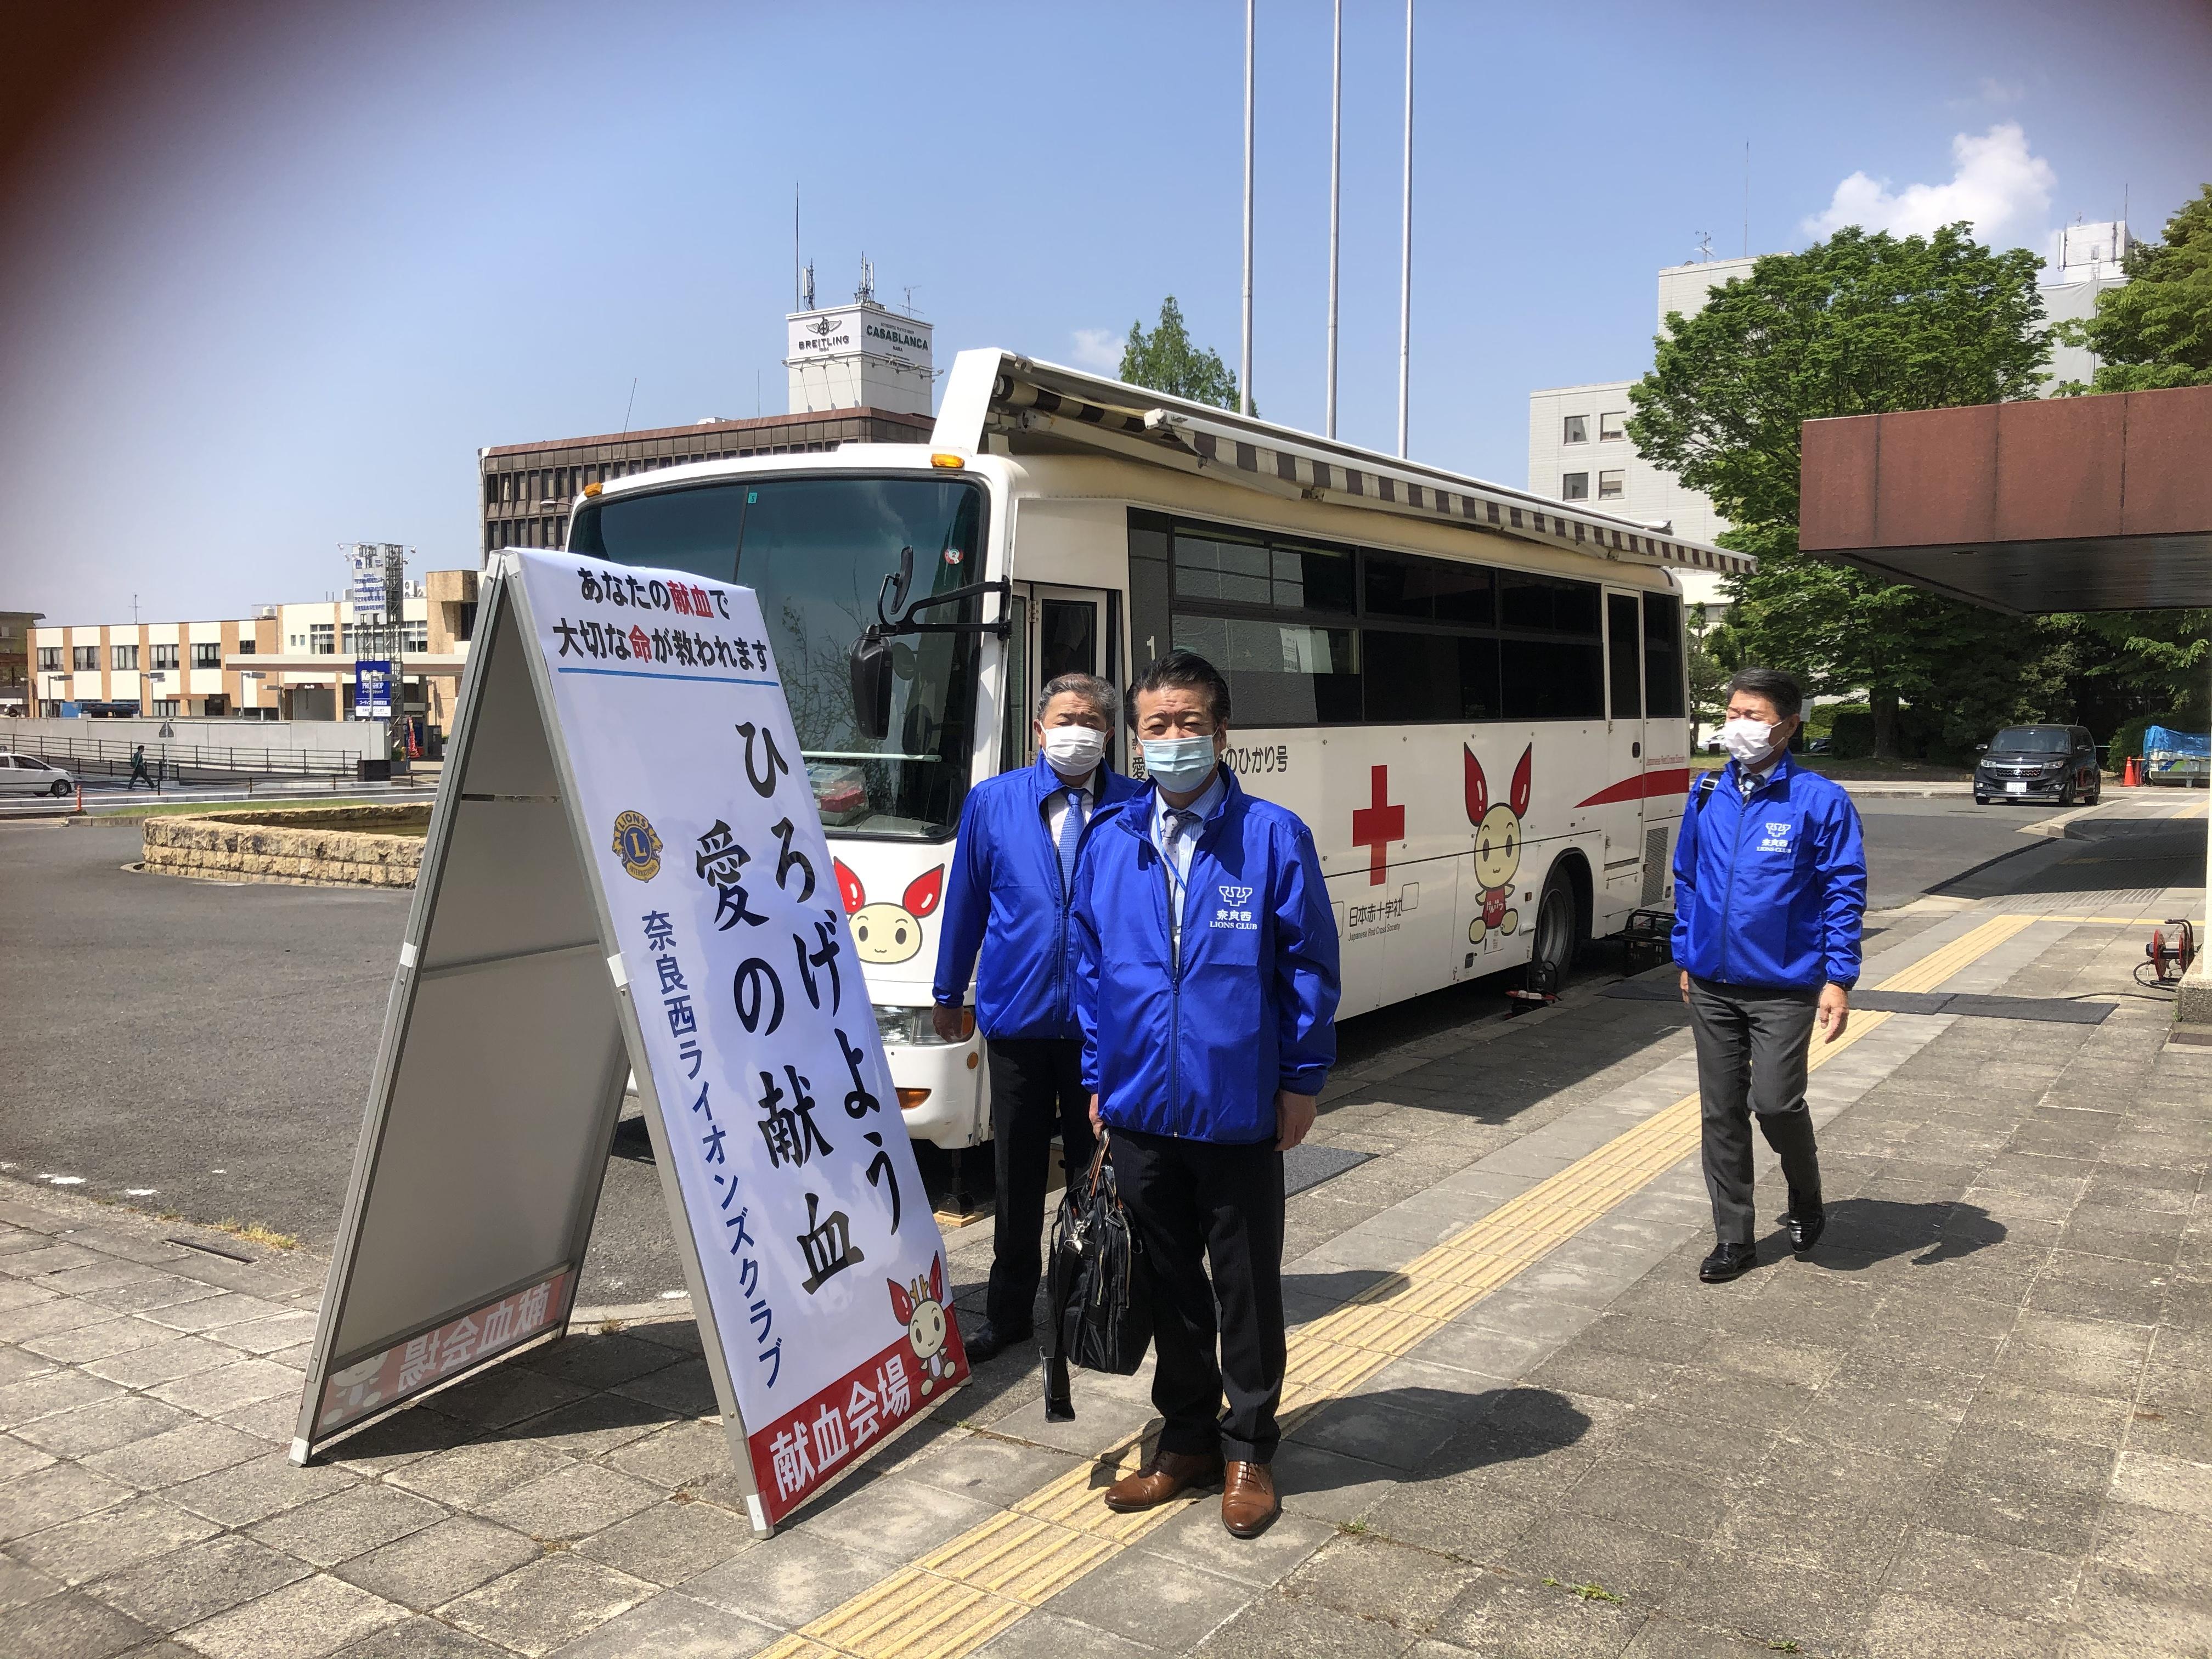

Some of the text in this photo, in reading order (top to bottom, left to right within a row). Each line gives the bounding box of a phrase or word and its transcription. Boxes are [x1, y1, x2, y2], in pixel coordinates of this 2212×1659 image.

[799, 335, 850, 351] BREITLING
[866, 325, 929, 351] CASABLANCA
[578, 567, 730, 620] あなたの献血で
[553, 617, 768, 672] 大切な命が救われます
[1132, 746, 1288, 781] 愛 のひかり号
[617, 813, 646, 829] LIONS
[630, 833, 647, 857] L
[1209, 921, 1234, 929] LIONS
[1216, 909, 1252, 922] 奈良西
[1349, 897, 1402, 927] 日本赤十字社
[1348, 931, 1368, 942] Japanese
[1376, 926, 1386, 935] Cross
[736, 721, 902, 1236] ひろげよう
[696, 819, 865, 1295] 愛の献血
[642, 911, 782, 1389] 奈良西ライオンズクラブ
[770, 1353, 911, 1502] 献血会場
